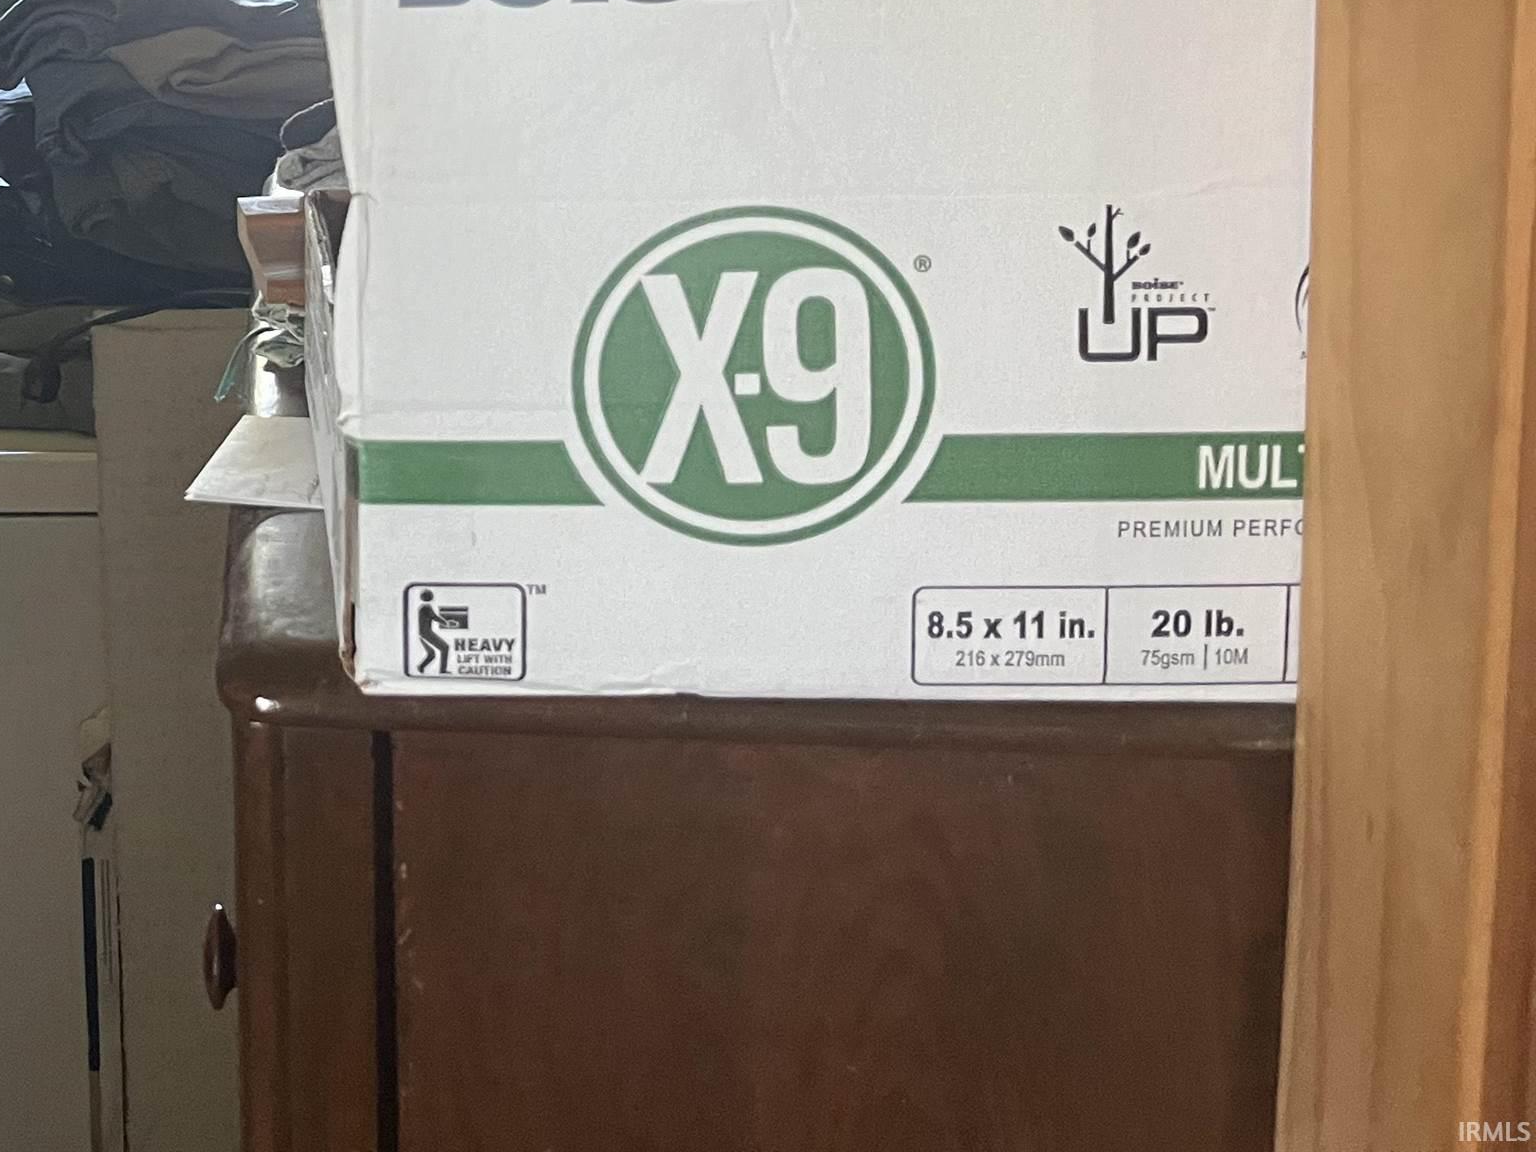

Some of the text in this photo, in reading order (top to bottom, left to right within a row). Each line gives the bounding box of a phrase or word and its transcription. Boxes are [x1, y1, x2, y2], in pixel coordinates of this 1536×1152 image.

[1131, 293, 1211, 302] PROJECT
[1078, 306, 1208, 362] UP
[640, 267, 872, 485] X-9
[1198, 444, 1305, 489] MUL
[1117, 520, 1223, 538] PREMIUM
[927, 610, 1095, 639] 8.5 x 11 in.
[1151, 609, 1244, 638] 20 lb.
[454, 638, 515, 651] HEAVY
[457, 654, 512, 663] LIFT WITH
[955, 650, 1065, 667] 216 x 279mm
[1141, 648, 1248, 669] 75gsm 10M
[458, 666, 511, 675] CAUTION
